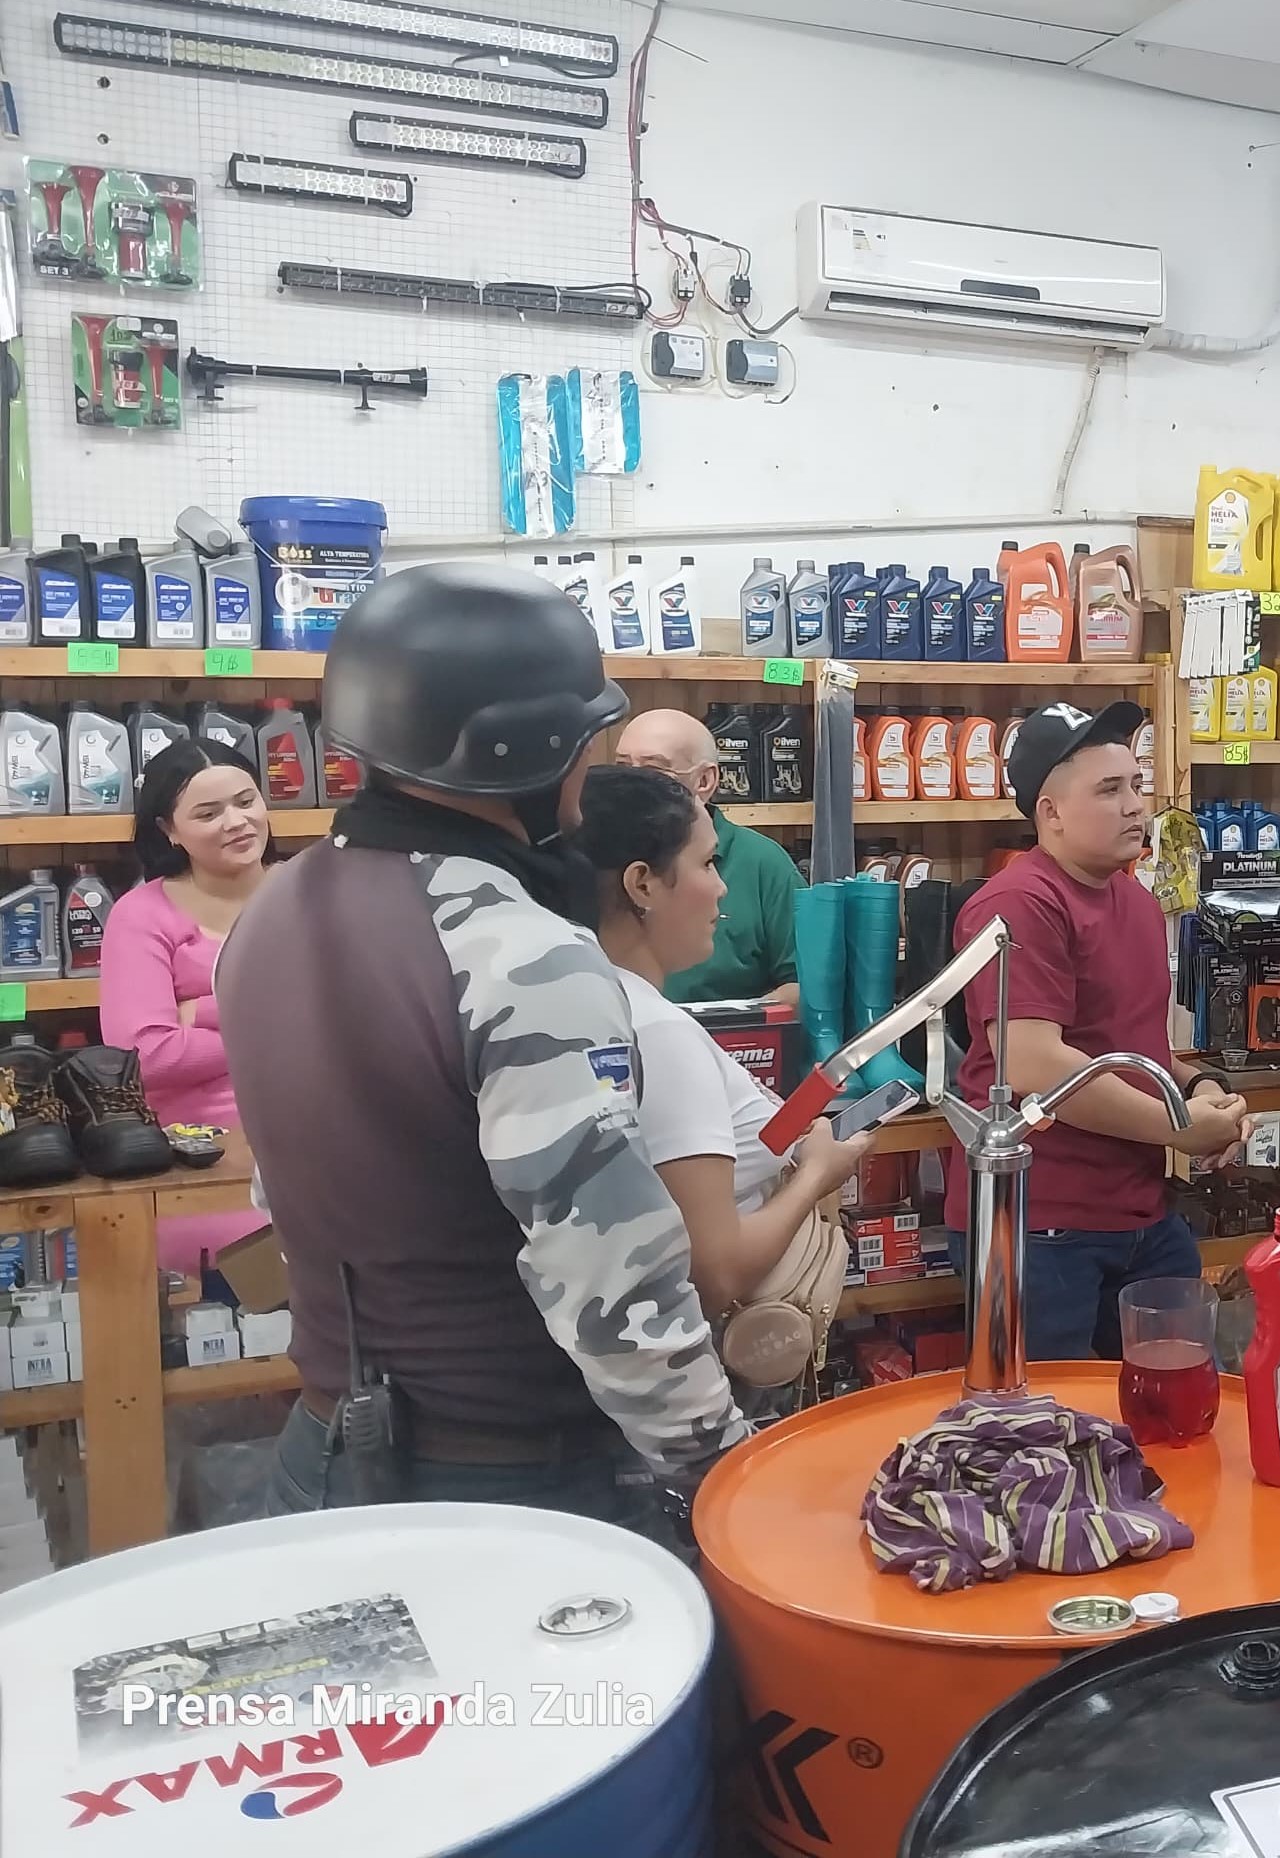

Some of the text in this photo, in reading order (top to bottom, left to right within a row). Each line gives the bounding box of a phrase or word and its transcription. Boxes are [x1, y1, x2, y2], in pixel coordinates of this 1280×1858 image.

[1211, 511, 1238, 519] HELIX
[717, 737, 749, 747] Oilven
[773, 737, 801, 746] Oilven
[1223, 861, 1277, 875] PLATINUM
